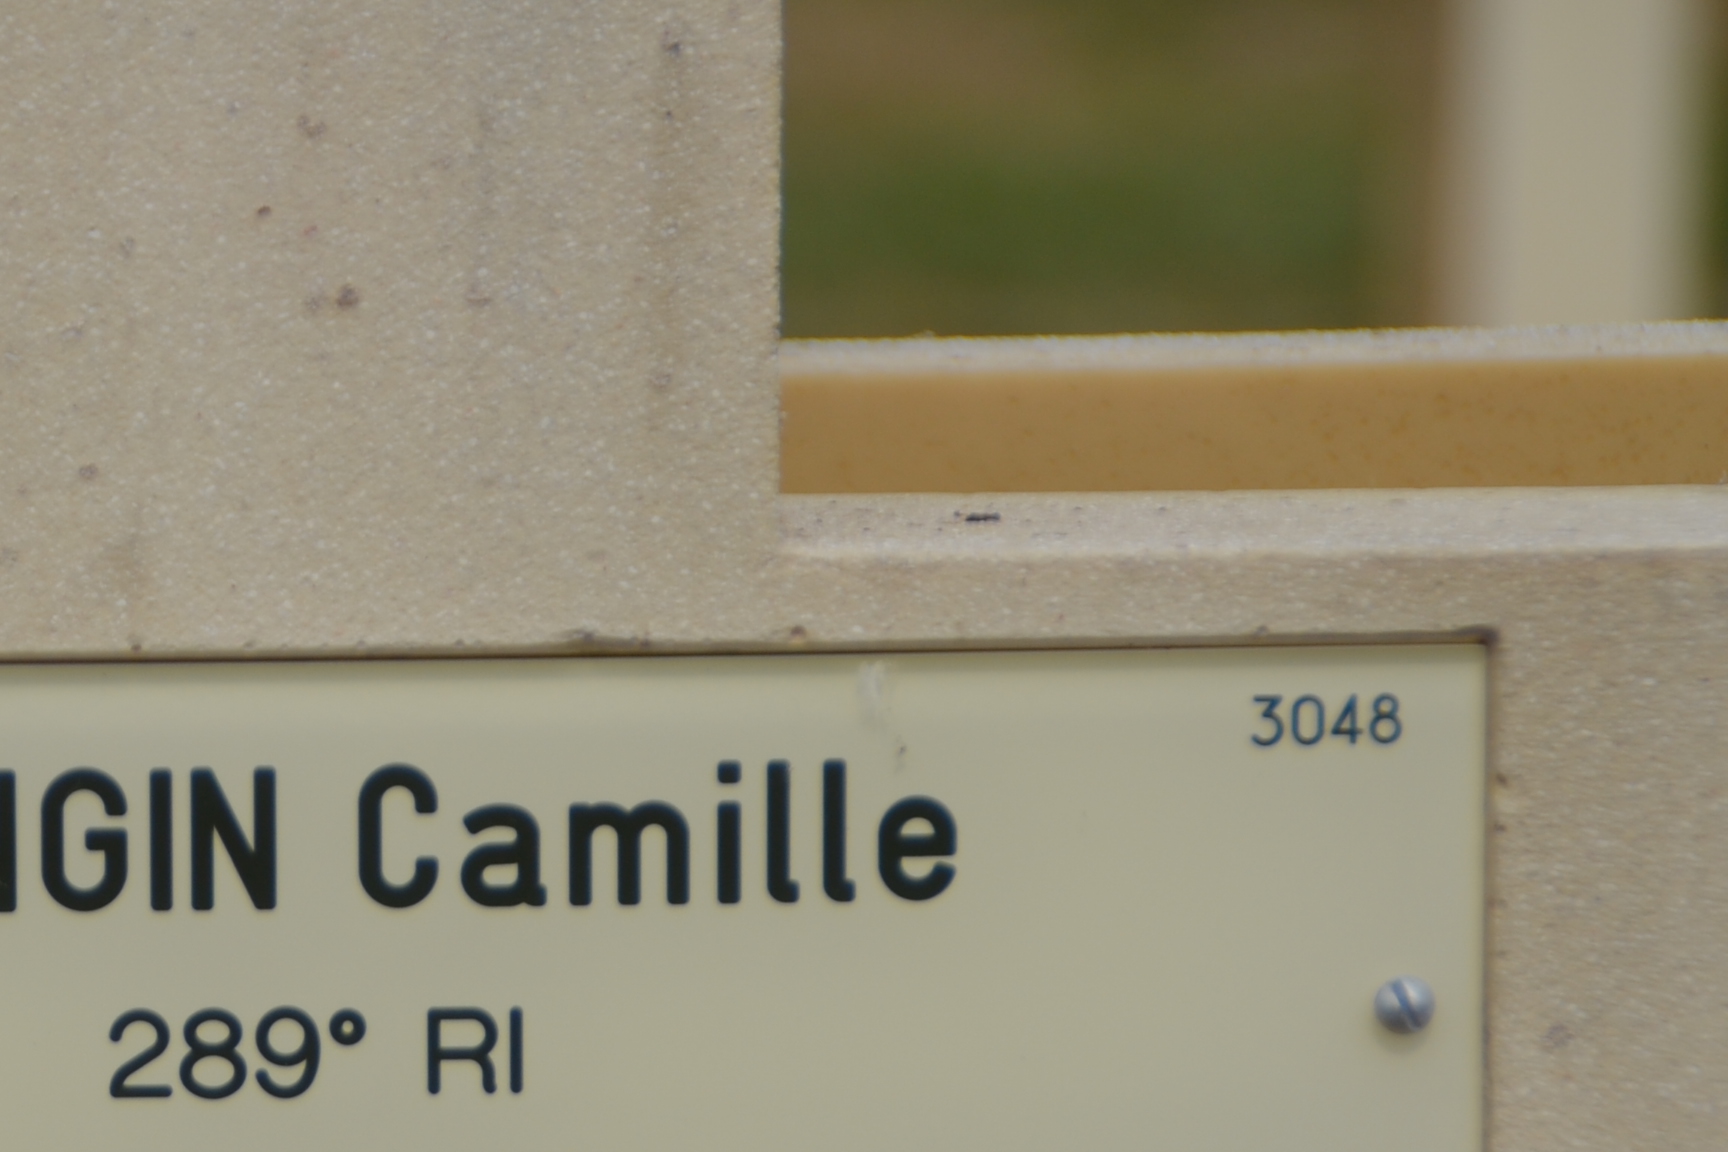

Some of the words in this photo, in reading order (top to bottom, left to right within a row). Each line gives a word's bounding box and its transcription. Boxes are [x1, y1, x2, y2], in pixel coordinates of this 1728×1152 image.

[1249, 692, 1405, 749] 3048
[356, 757, 960, 912] Camille
[425, 1005, 526, 1098] RI
